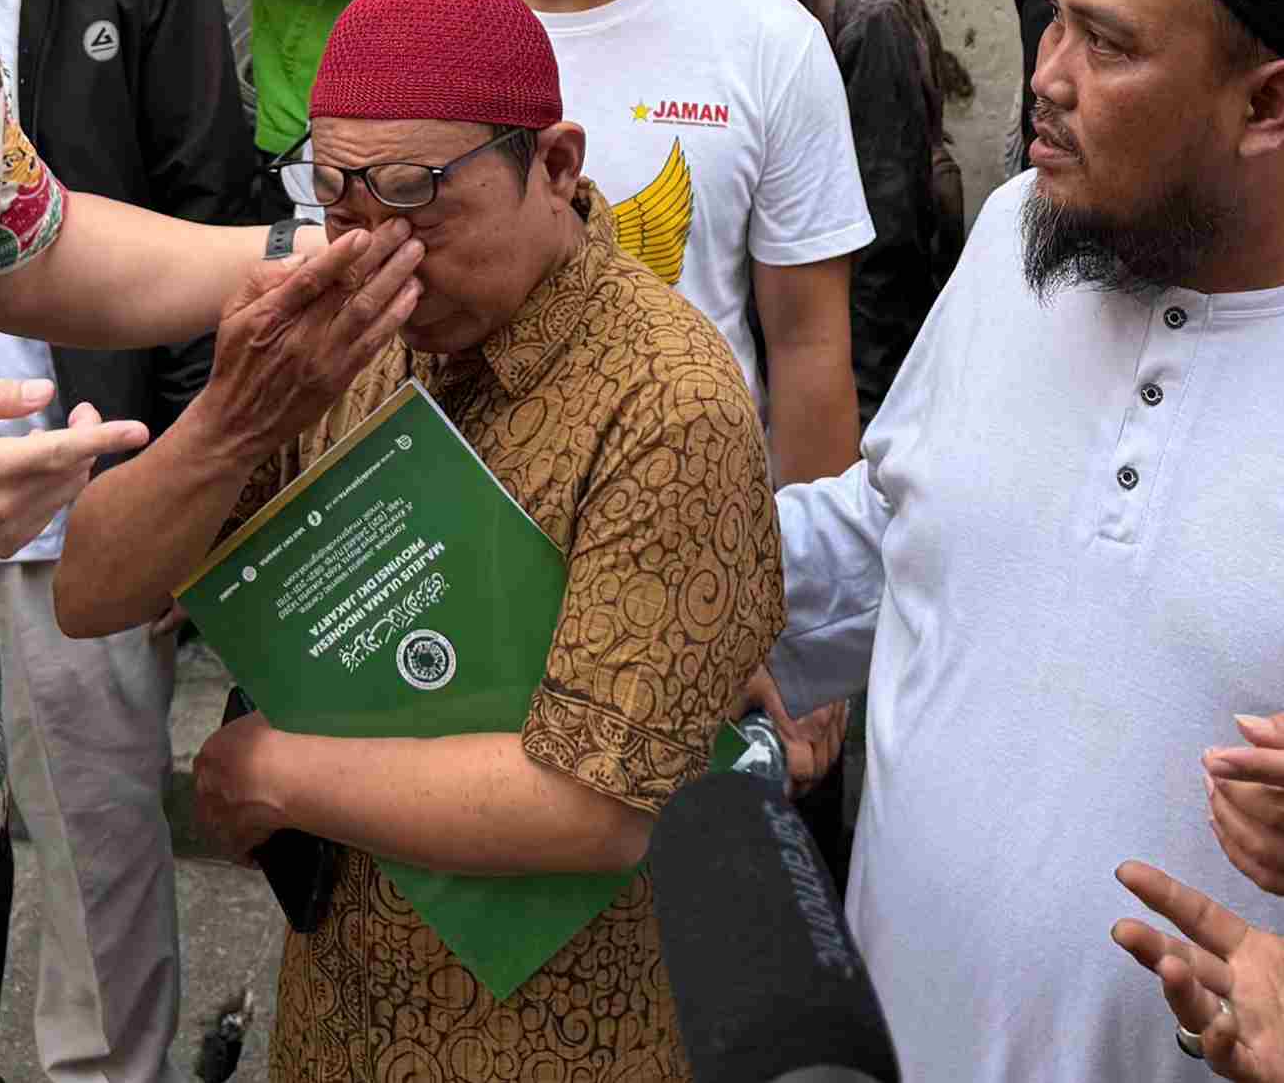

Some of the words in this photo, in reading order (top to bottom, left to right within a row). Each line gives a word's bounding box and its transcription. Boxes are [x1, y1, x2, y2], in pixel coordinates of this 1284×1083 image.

[652, 100, 729, 123] JAMAN
[374, 537, 426, 584] PROVINSI
[399, 541, 446, 582] MAJELIS
[355, 578, 378, 599] DKI
[362, 577, 403, 612] ULAMA
[308, 593, 357, 637] JAKARTA
[308, 607, 367, 658] INDONESIA
